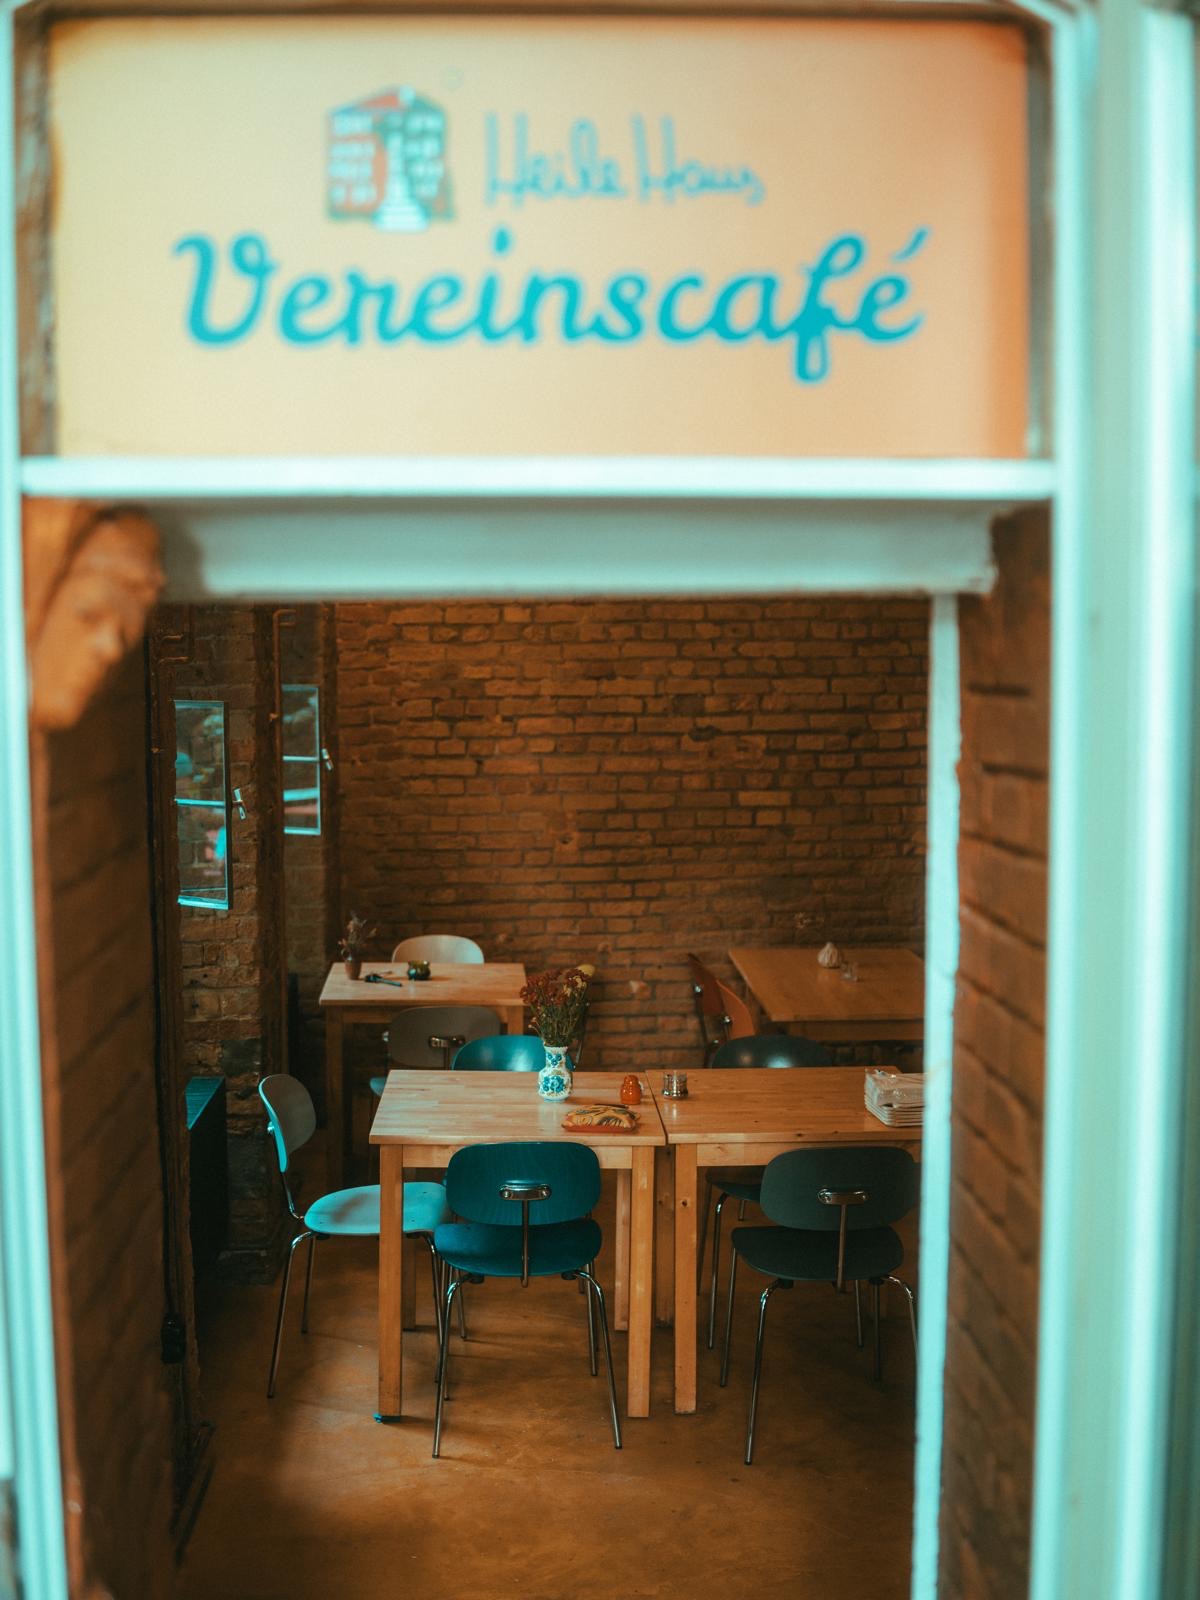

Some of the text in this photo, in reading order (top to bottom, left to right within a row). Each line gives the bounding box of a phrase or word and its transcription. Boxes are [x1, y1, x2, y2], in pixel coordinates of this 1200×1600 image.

[485, 112, 766, 207] Heile Haus
[174, 225, 929, 384] Vereinscafé
